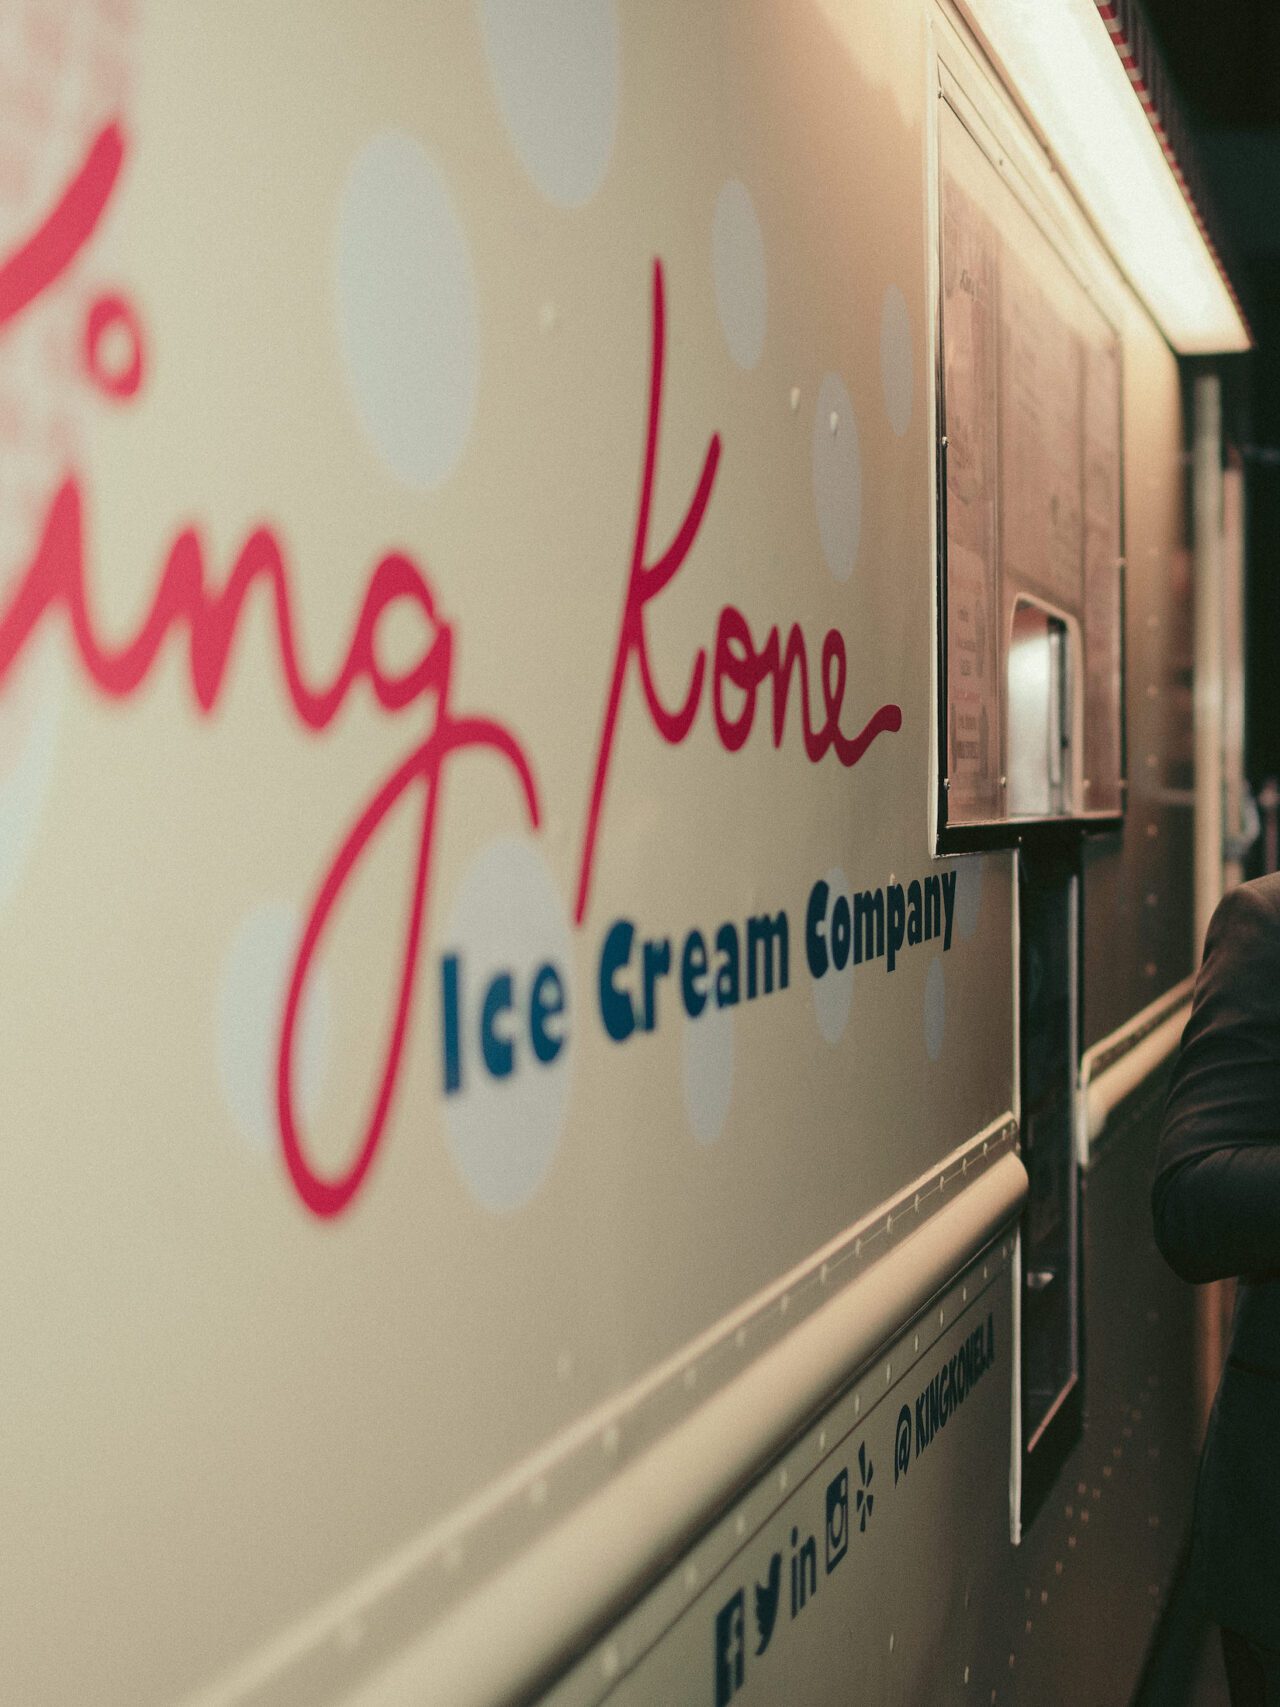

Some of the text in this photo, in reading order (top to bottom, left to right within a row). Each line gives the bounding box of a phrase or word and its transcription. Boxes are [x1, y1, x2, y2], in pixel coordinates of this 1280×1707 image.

[0, 119, 902, 1224] ing Kone
[441, 870, 957, 1093] Ice Cream Company
[791, 1526, 817, 1620] in
